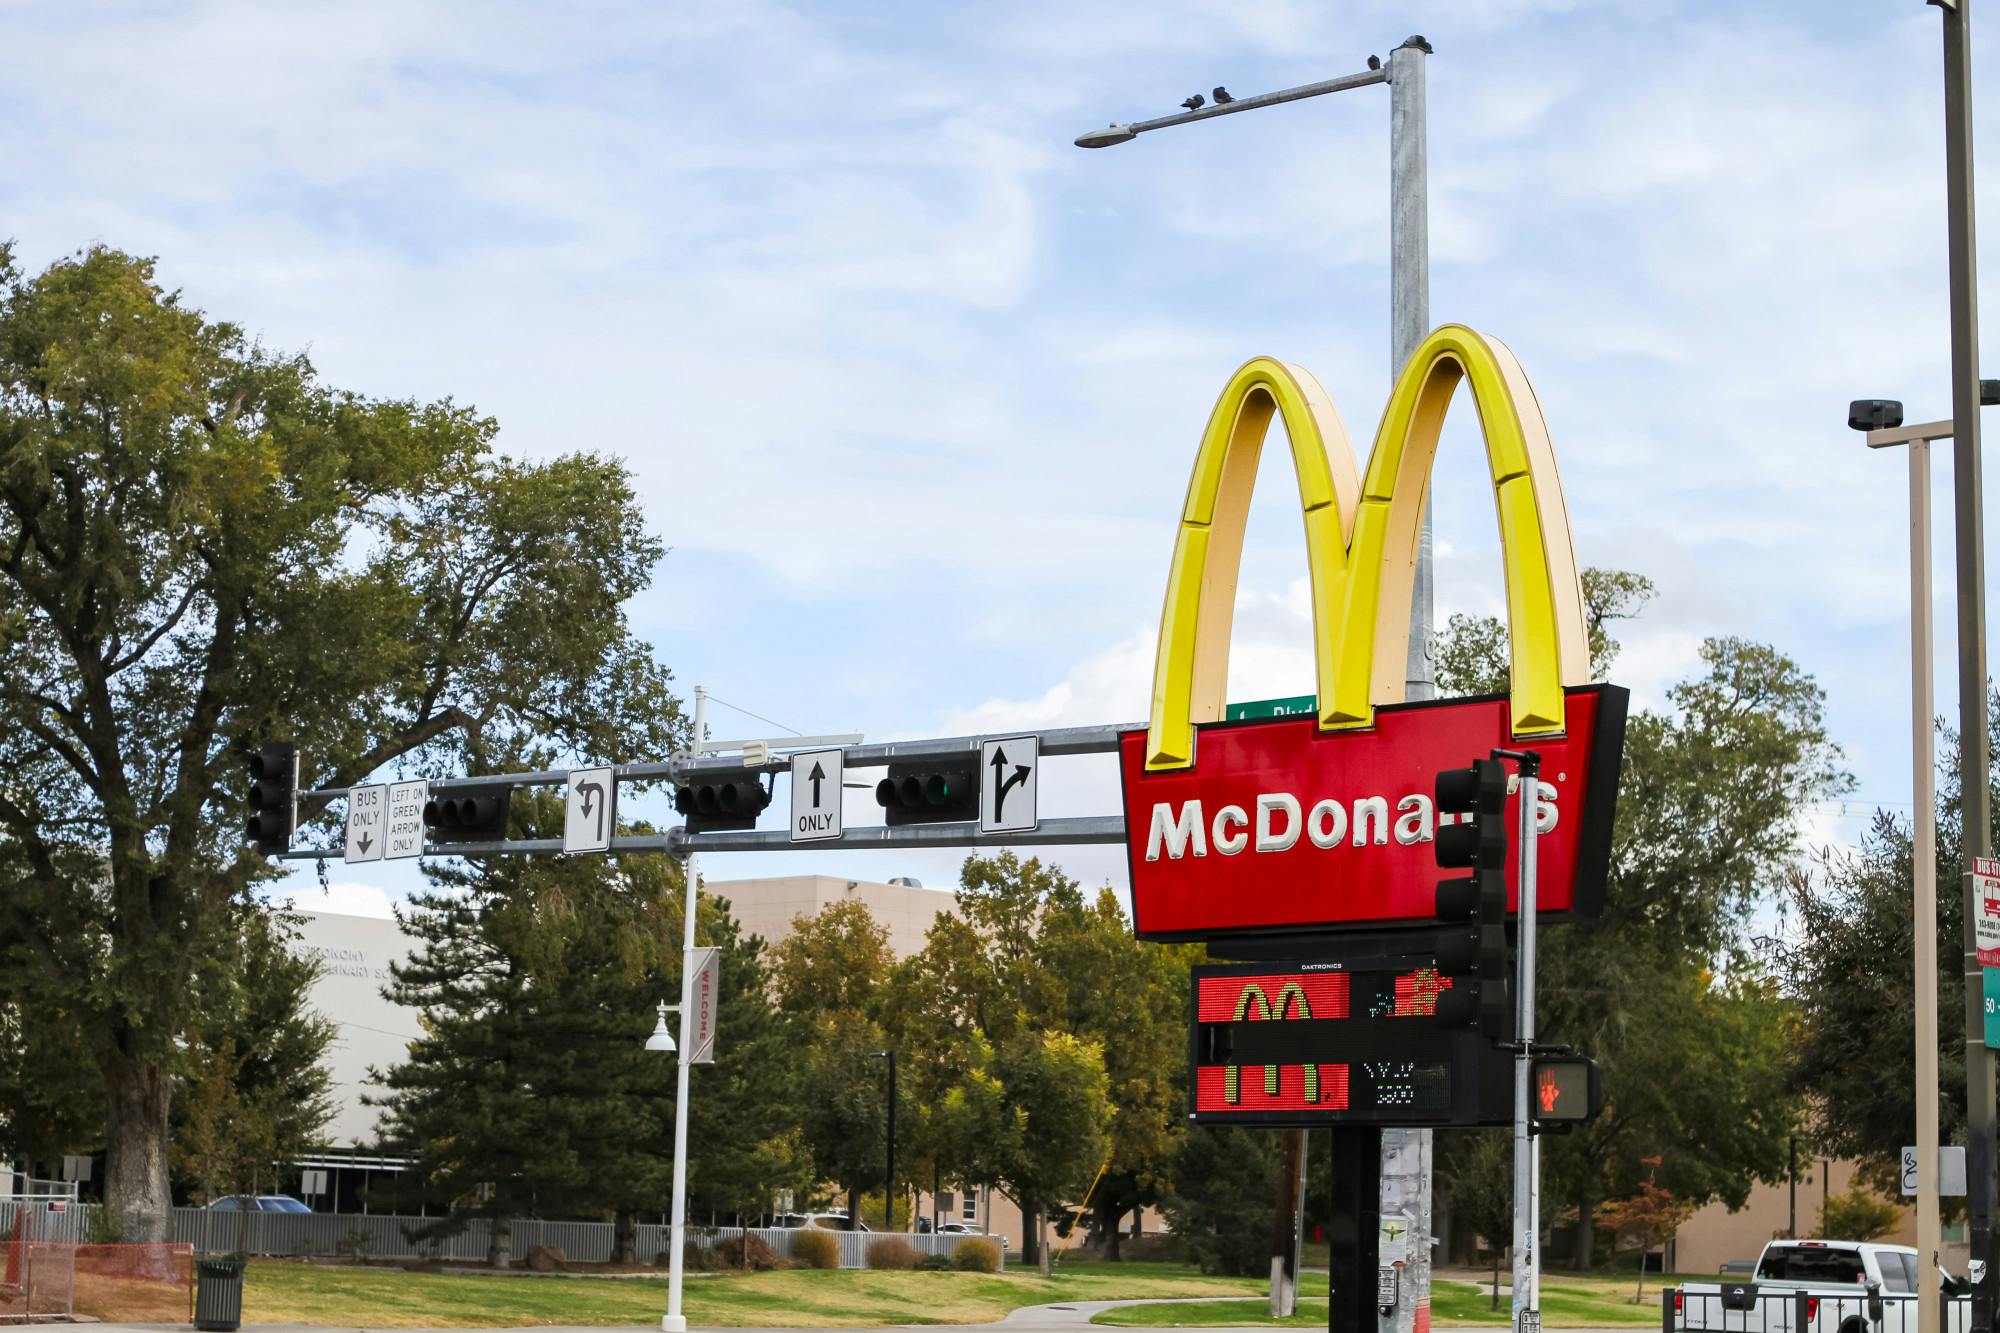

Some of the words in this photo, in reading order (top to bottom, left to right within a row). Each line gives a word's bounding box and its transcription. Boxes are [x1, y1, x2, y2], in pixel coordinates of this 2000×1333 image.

[1273, 703, 1313, 716] Bld
[357, 791, 377, 807] BUS
[392, 789, 410, 803] LEFT
[413, 787, 423, 800] ON
[353, 811, 379, 827] ONLY
[393, 805, 420, 818] GREEN
[1145, 773, 1559, 862] McDona's
[391, 821, 420, 835] ARROW
[798, 812, 833, 832] ONLY
[393, 838, 414, 851] ONLY
[1977, 860, 1990, 875] BUS
[1991, 861, 2000, 877] ST
[700, 970, 709, 1040] WELCOME
